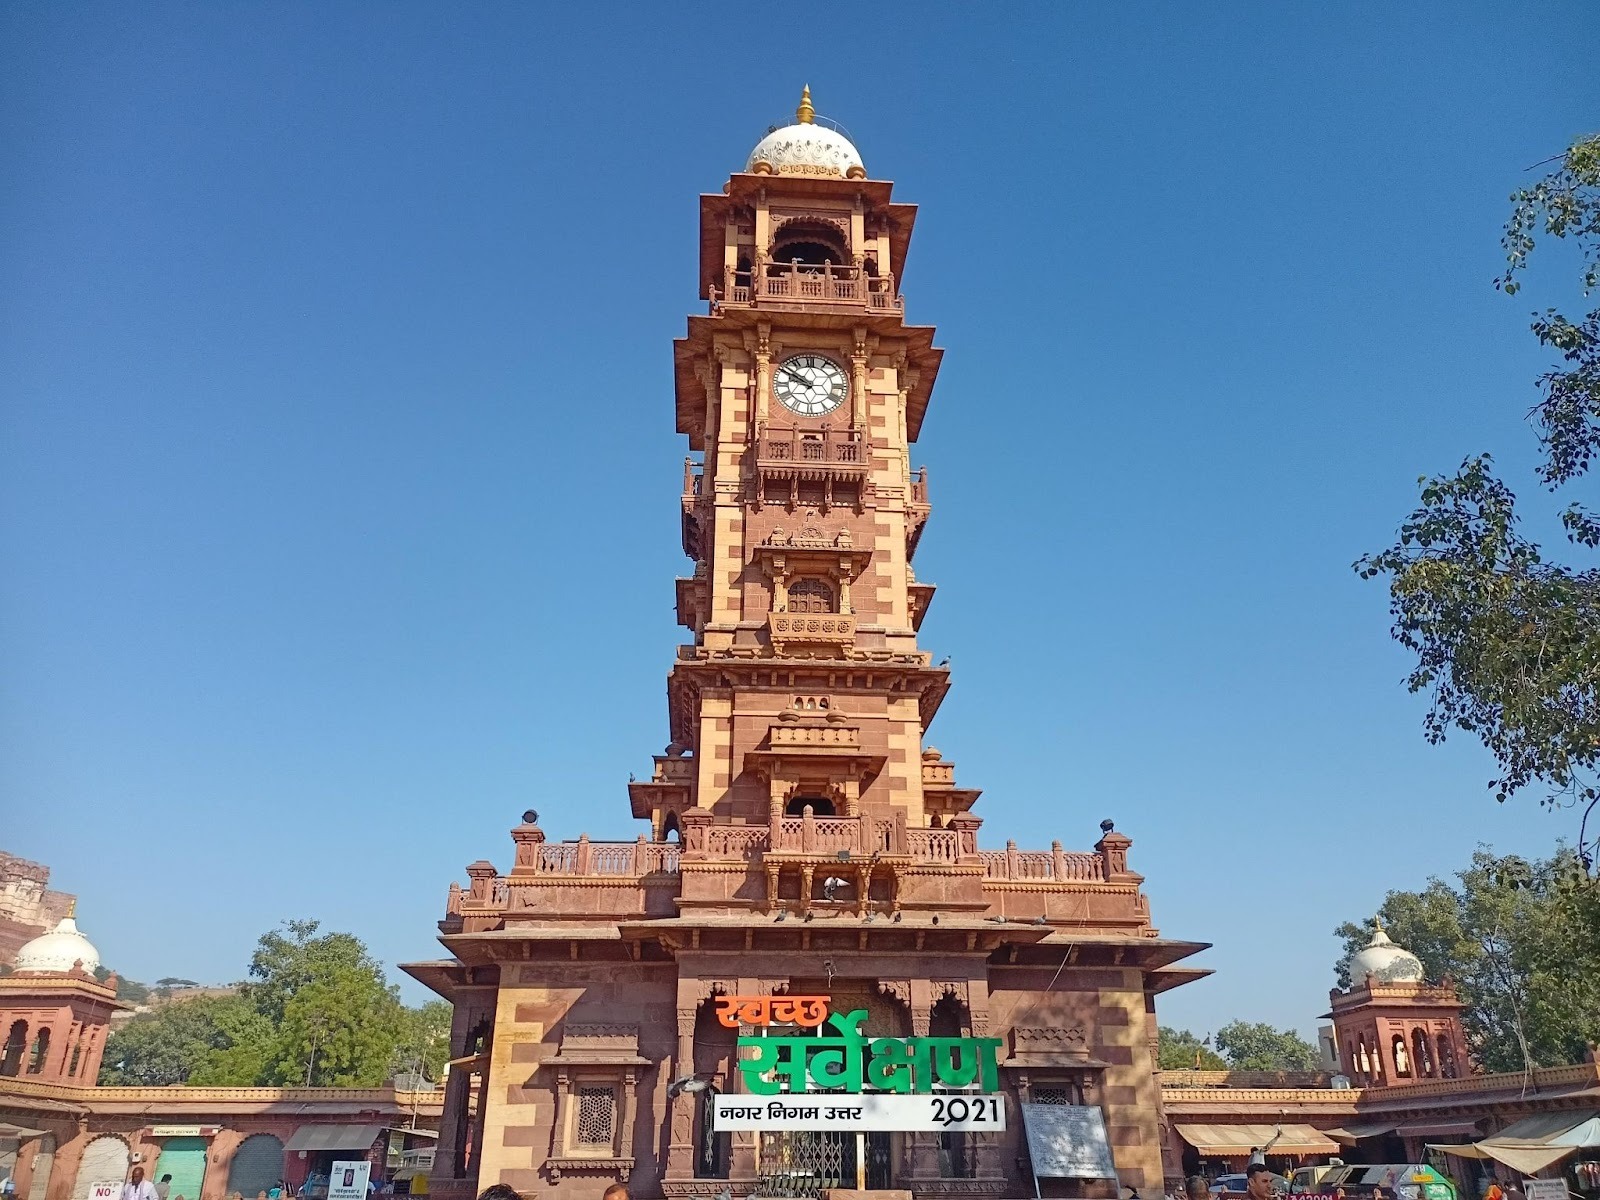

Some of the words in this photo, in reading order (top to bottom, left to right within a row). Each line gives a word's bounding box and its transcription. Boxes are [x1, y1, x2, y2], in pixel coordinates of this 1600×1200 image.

[715, 996, 831, 1027] स्वच्छ
[737, 1009, 1003, 1095] सर्वेक्षण
[720, 1107, 763, 1119] नगर
[767, 1102, 820, 1120] निगम
[824, 1107, 863, 1120] उत्तर
[932, 1098, 998, 1127] 2021
